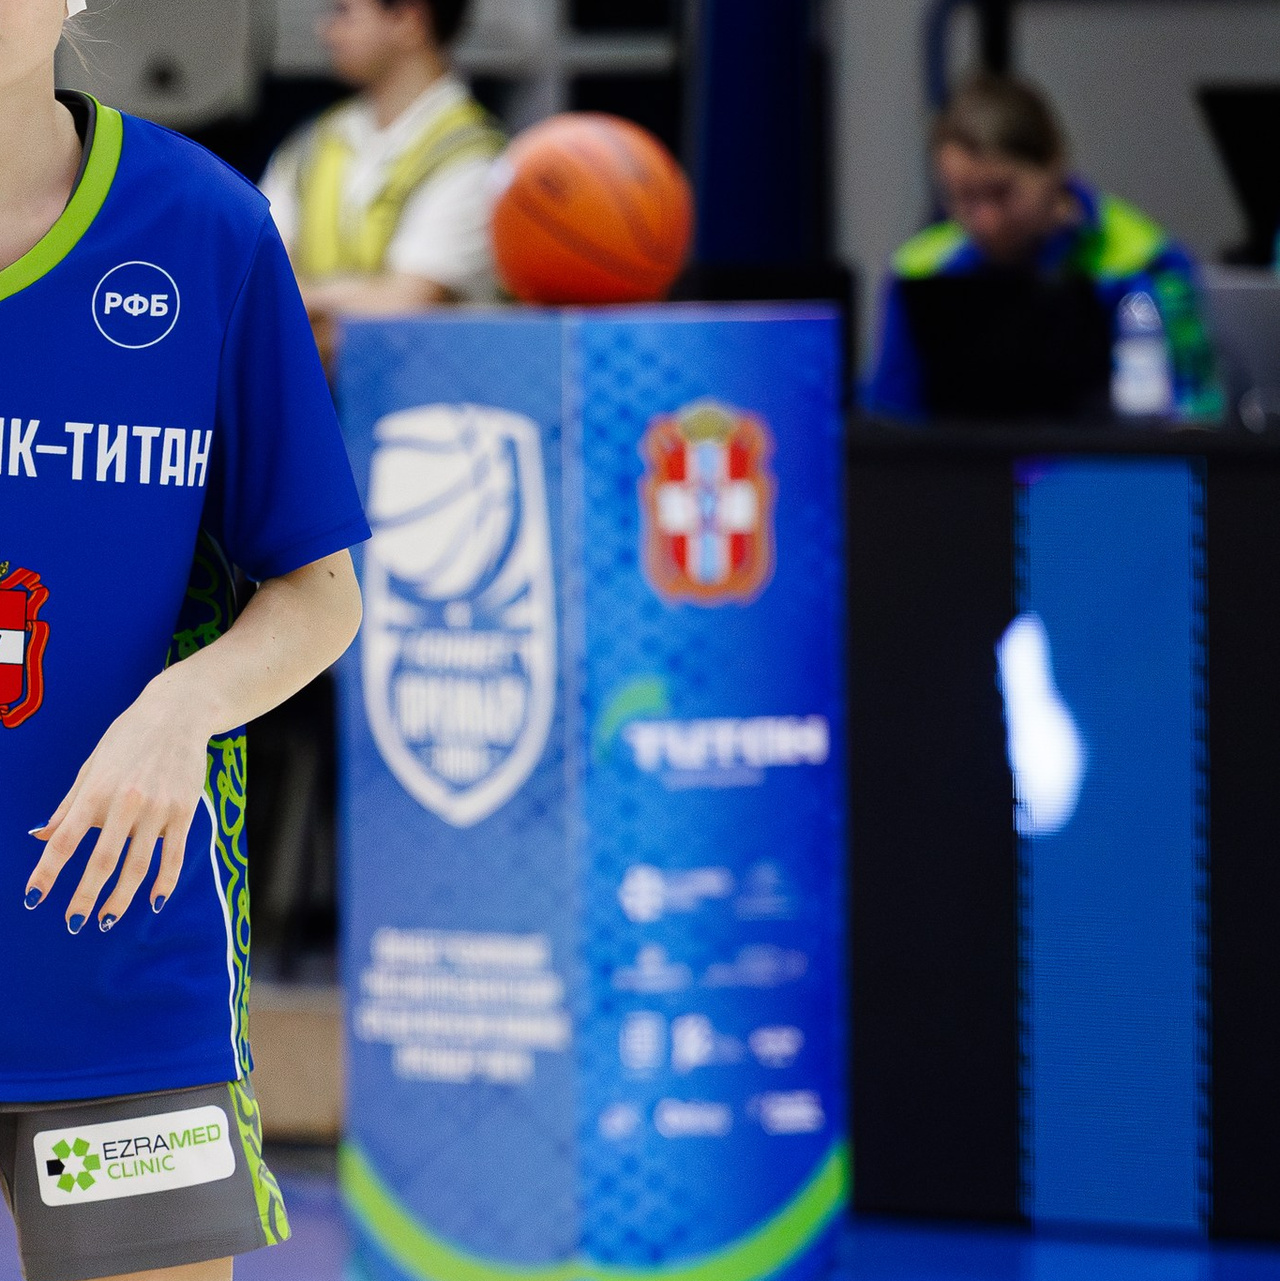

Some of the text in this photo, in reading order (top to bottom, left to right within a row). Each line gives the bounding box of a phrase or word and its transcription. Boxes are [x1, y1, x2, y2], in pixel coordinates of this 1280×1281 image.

[104, 292, 169, 317] РФБ
[102, 1123, 221, 1161] EZRAMED
[107, 1154, 176, 1180] CLINIC
